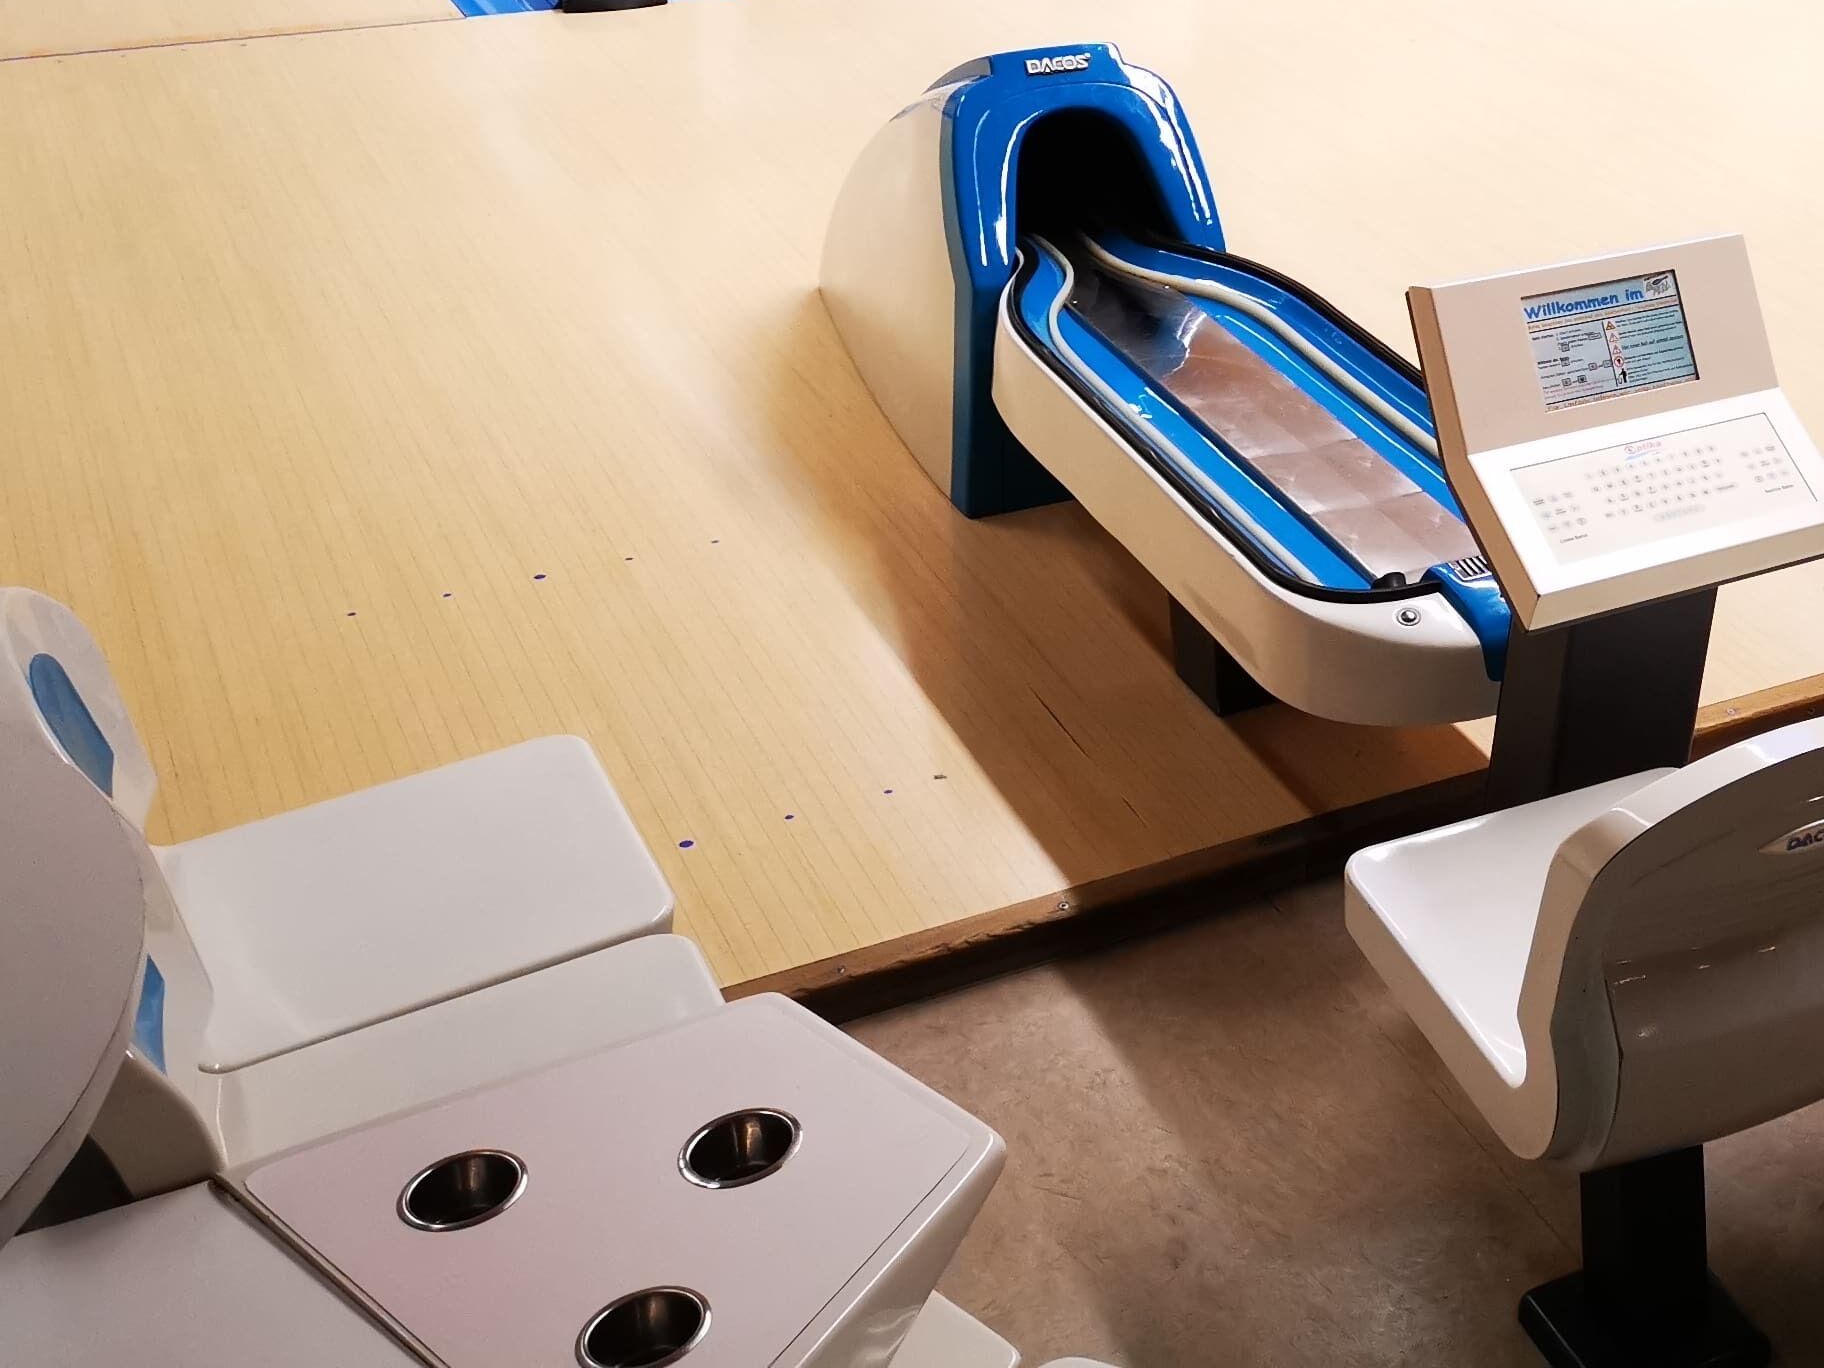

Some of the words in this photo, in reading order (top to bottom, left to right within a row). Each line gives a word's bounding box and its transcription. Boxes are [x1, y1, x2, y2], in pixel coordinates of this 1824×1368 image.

[1025, 52, 1090, 75] DACOS
[1524, 293, 1619, 320] Willkommen
[1625, 288, 1644, 302] im
